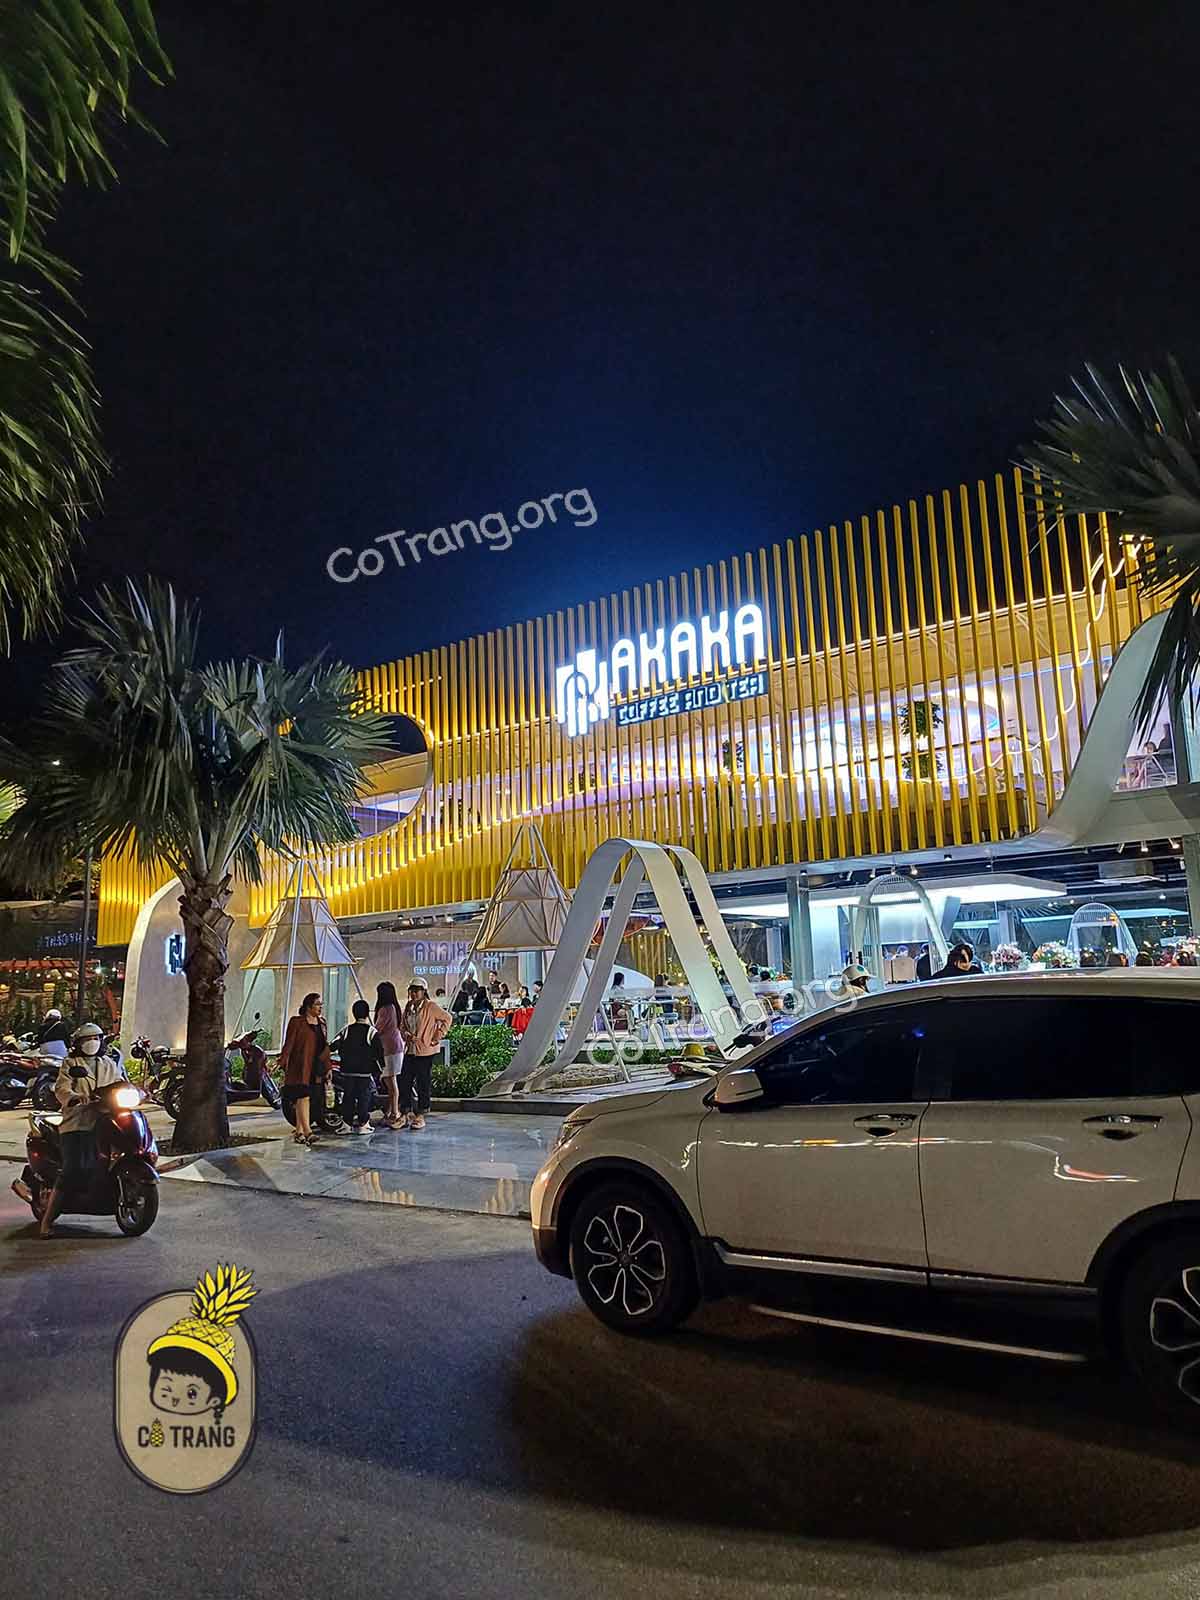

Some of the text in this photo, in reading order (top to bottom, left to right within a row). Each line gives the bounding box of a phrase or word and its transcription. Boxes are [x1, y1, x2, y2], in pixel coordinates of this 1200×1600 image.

[611, 603, 766, 694] AKAKA
[618, 673, 764, 725] COFFEE AND TEA
